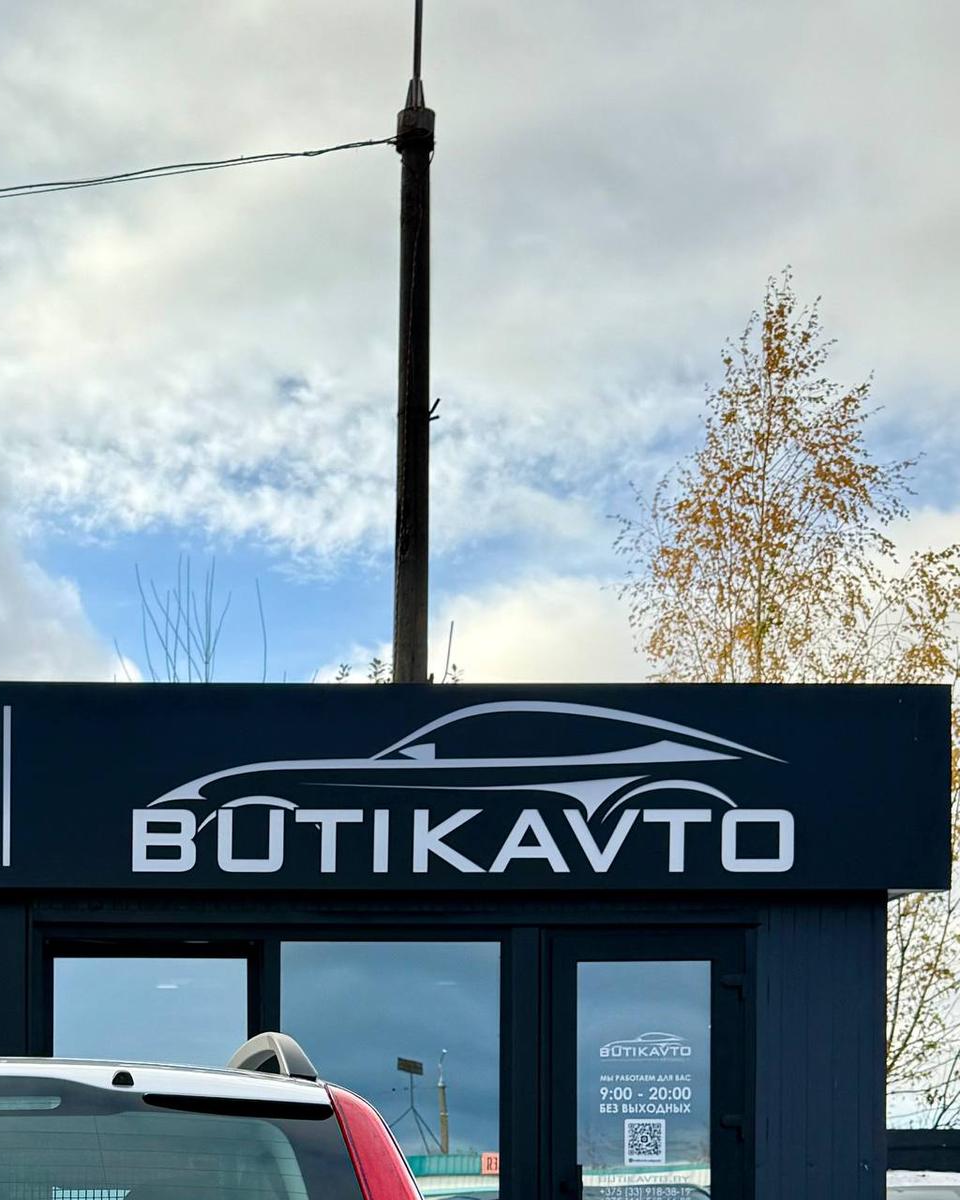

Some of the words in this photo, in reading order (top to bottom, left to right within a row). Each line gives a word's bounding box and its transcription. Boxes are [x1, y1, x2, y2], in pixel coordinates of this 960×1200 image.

[132, 808, 795, 874] BUTIKAVTO
[600, 1046, 691, 1057] BUTIKAVTO
[657, 1074, 673, 1082] ДЛЯ
[674, 1074, 692, 1082] ВАС
[600, 1087, 632, 1101] 9:00
[648, 1087, 692, 1100] 20:00
[600, 1103, 618, 1114] БЕЗ
[622, 1103, 691, 1114] ВЫХОДНЫХ
[600, 1187, 622, 1197] +375
[625, 1187, 642, 1198] (33)
